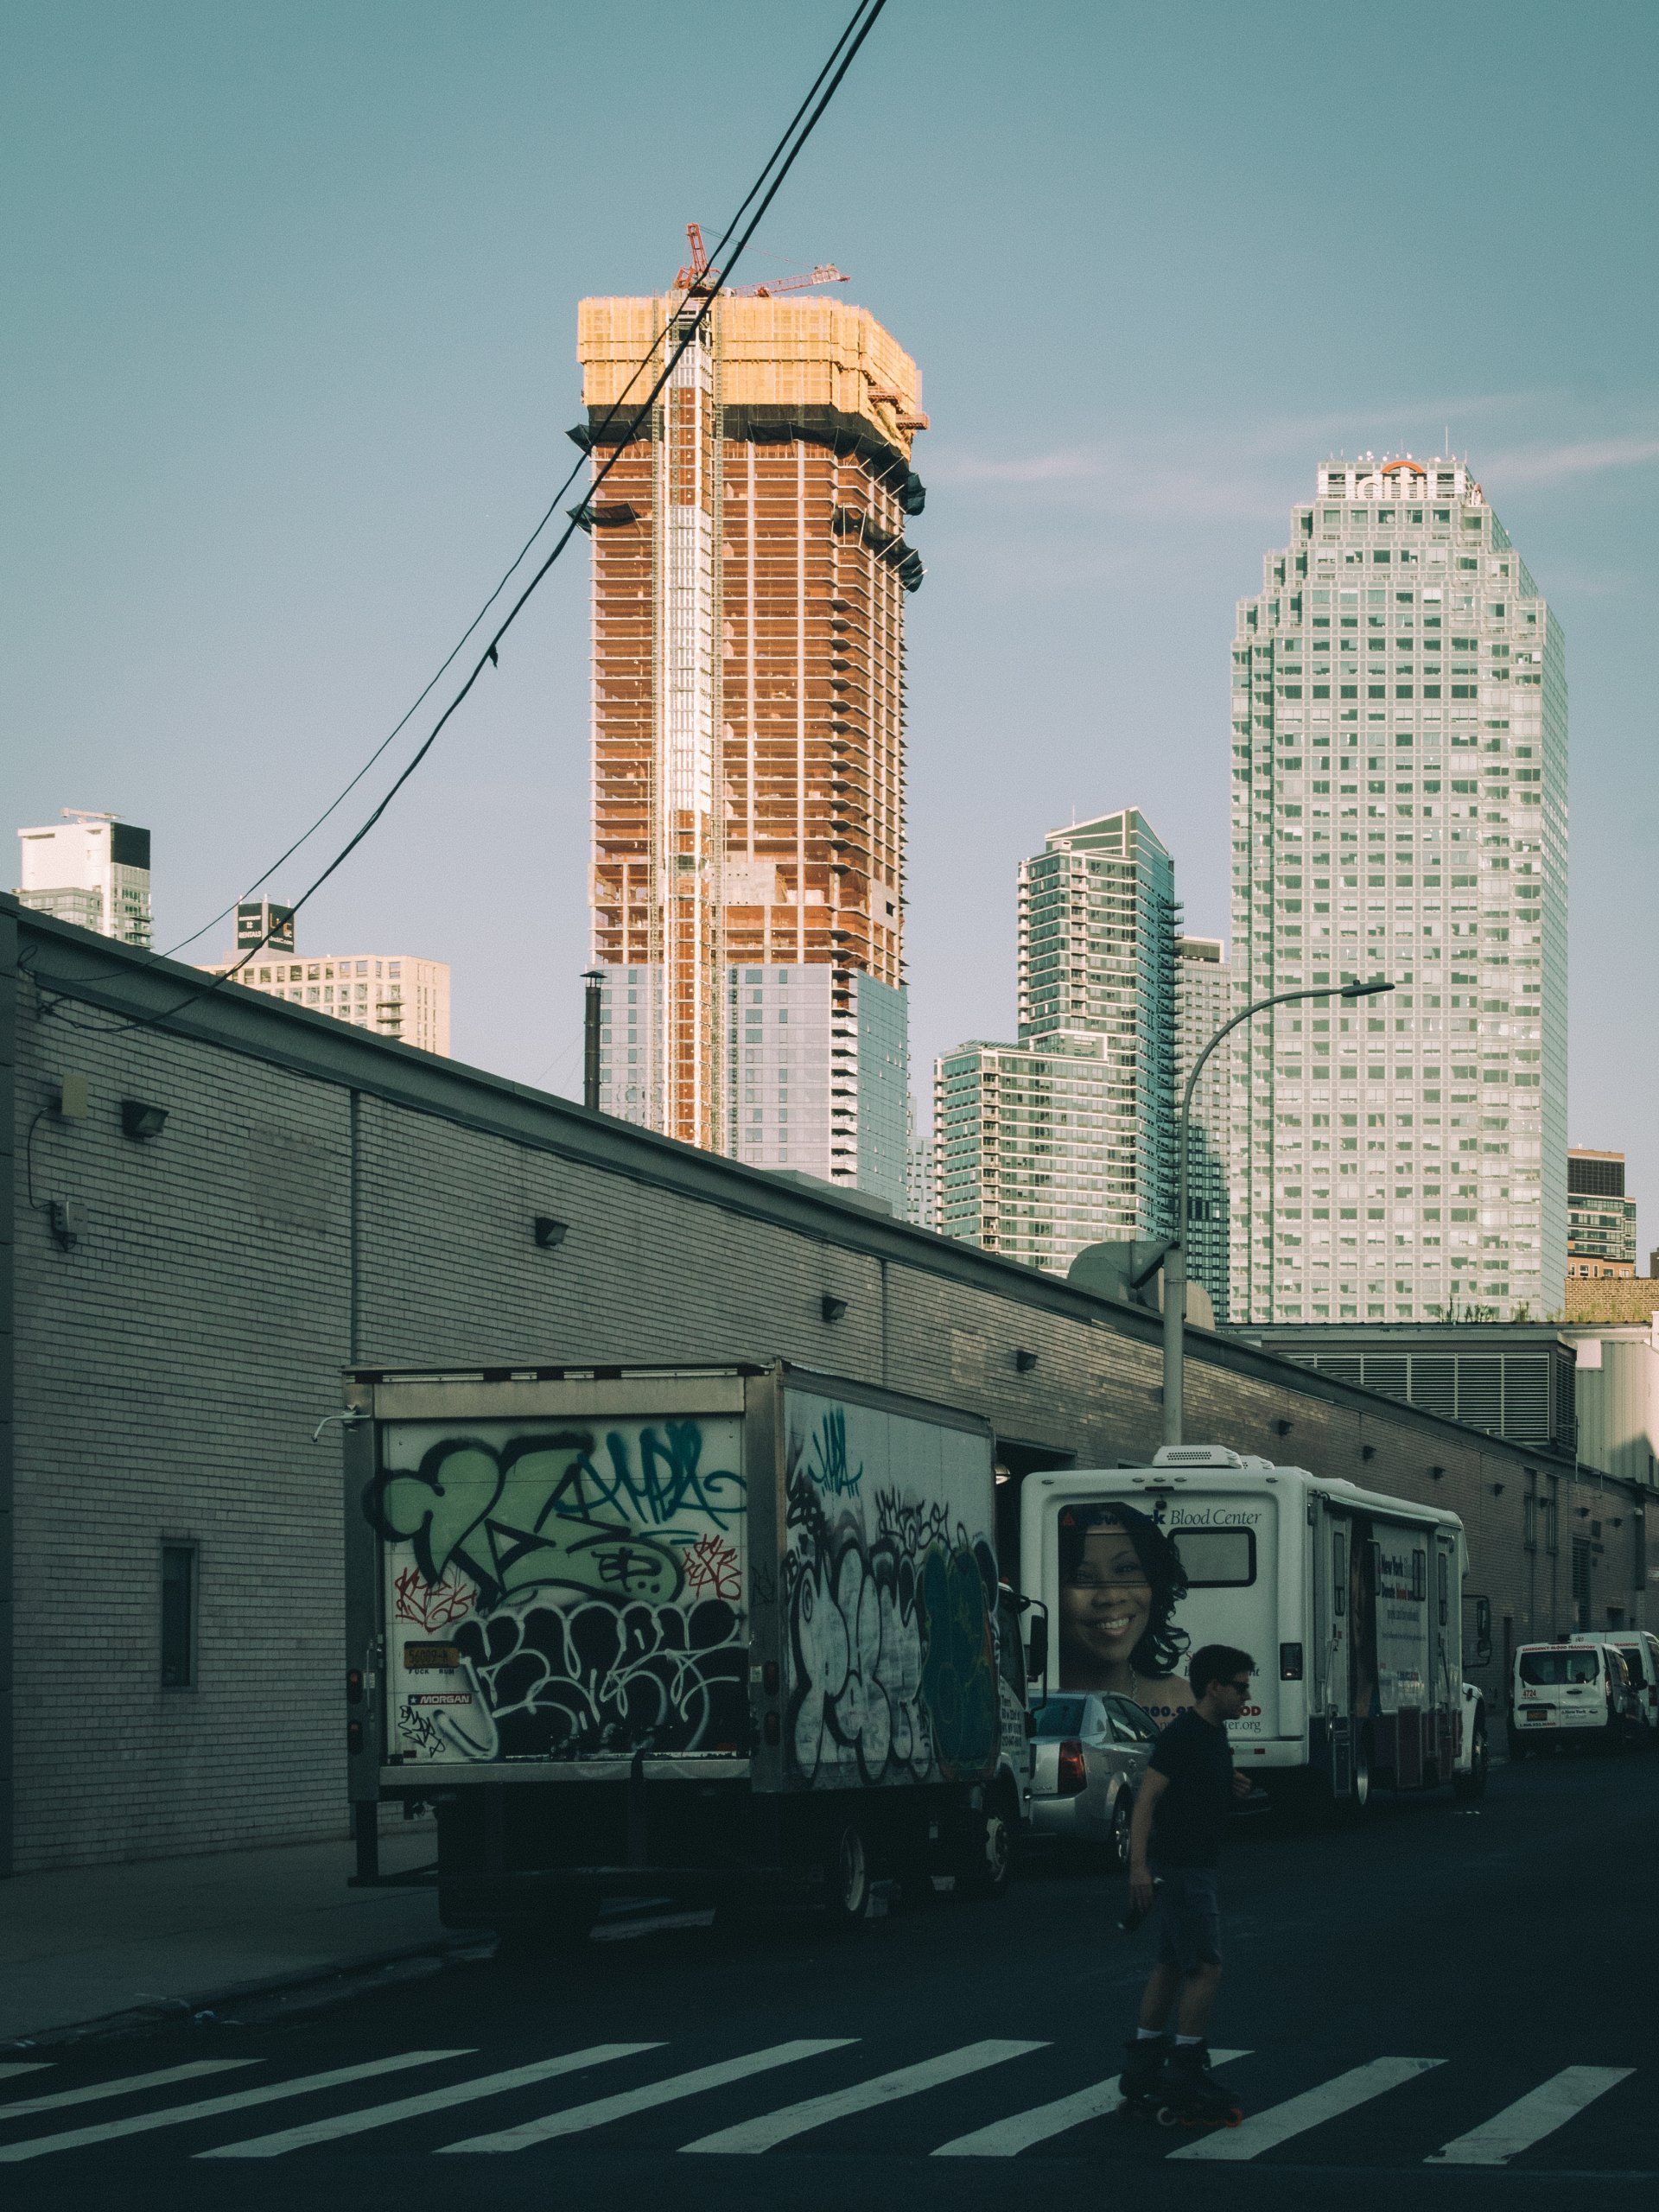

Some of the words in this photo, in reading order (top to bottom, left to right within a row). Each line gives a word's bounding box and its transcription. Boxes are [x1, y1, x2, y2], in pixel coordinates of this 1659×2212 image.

[1357, 465, 1424, 500] citi
[1171, 1509, 1210, 1525] Blood
[1213, 1509, 1262, 1525] Center
[420, 1694, 470, 1704] MORGAN
